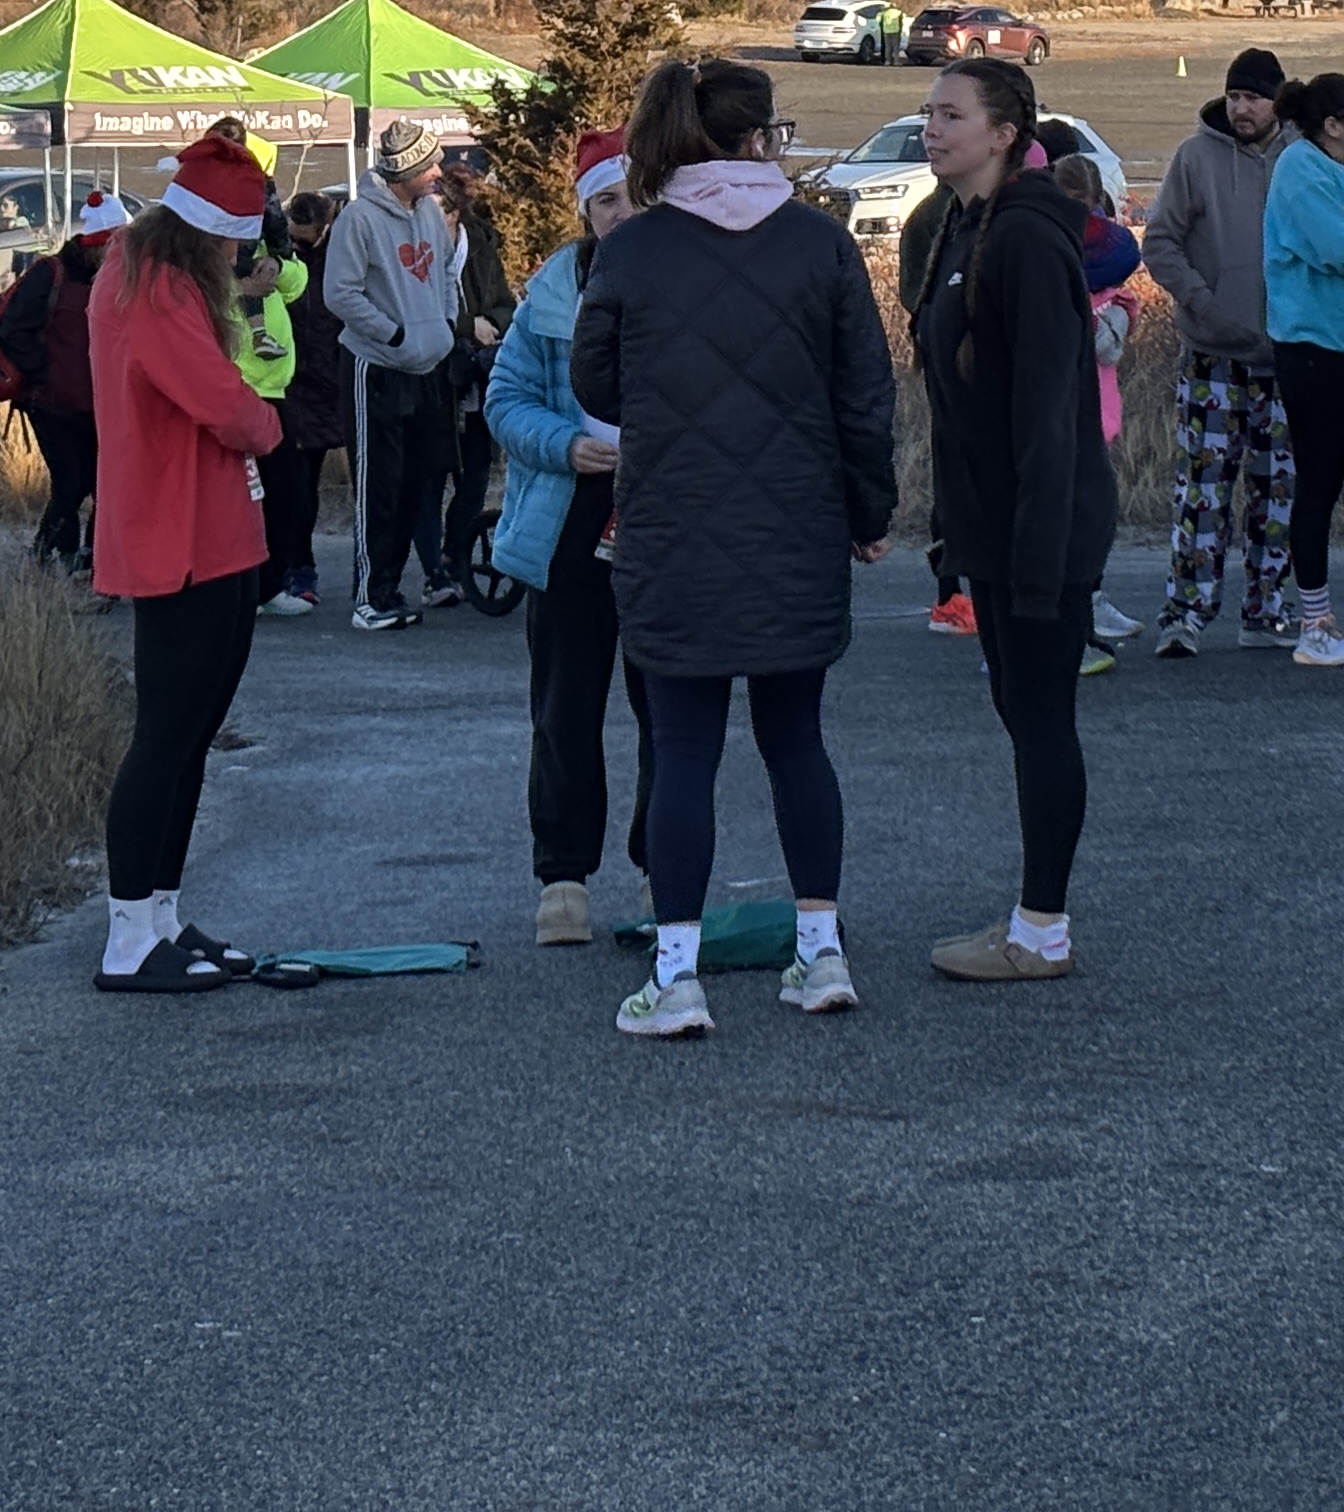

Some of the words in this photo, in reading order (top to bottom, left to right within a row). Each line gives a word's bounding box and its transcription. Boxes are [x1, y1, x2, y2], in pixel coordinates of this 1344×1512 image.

[80, 65, 251, 94] YUKAN
[94, 113, 173, 133] Imagine
[297, 109, 329, 129] Do.
